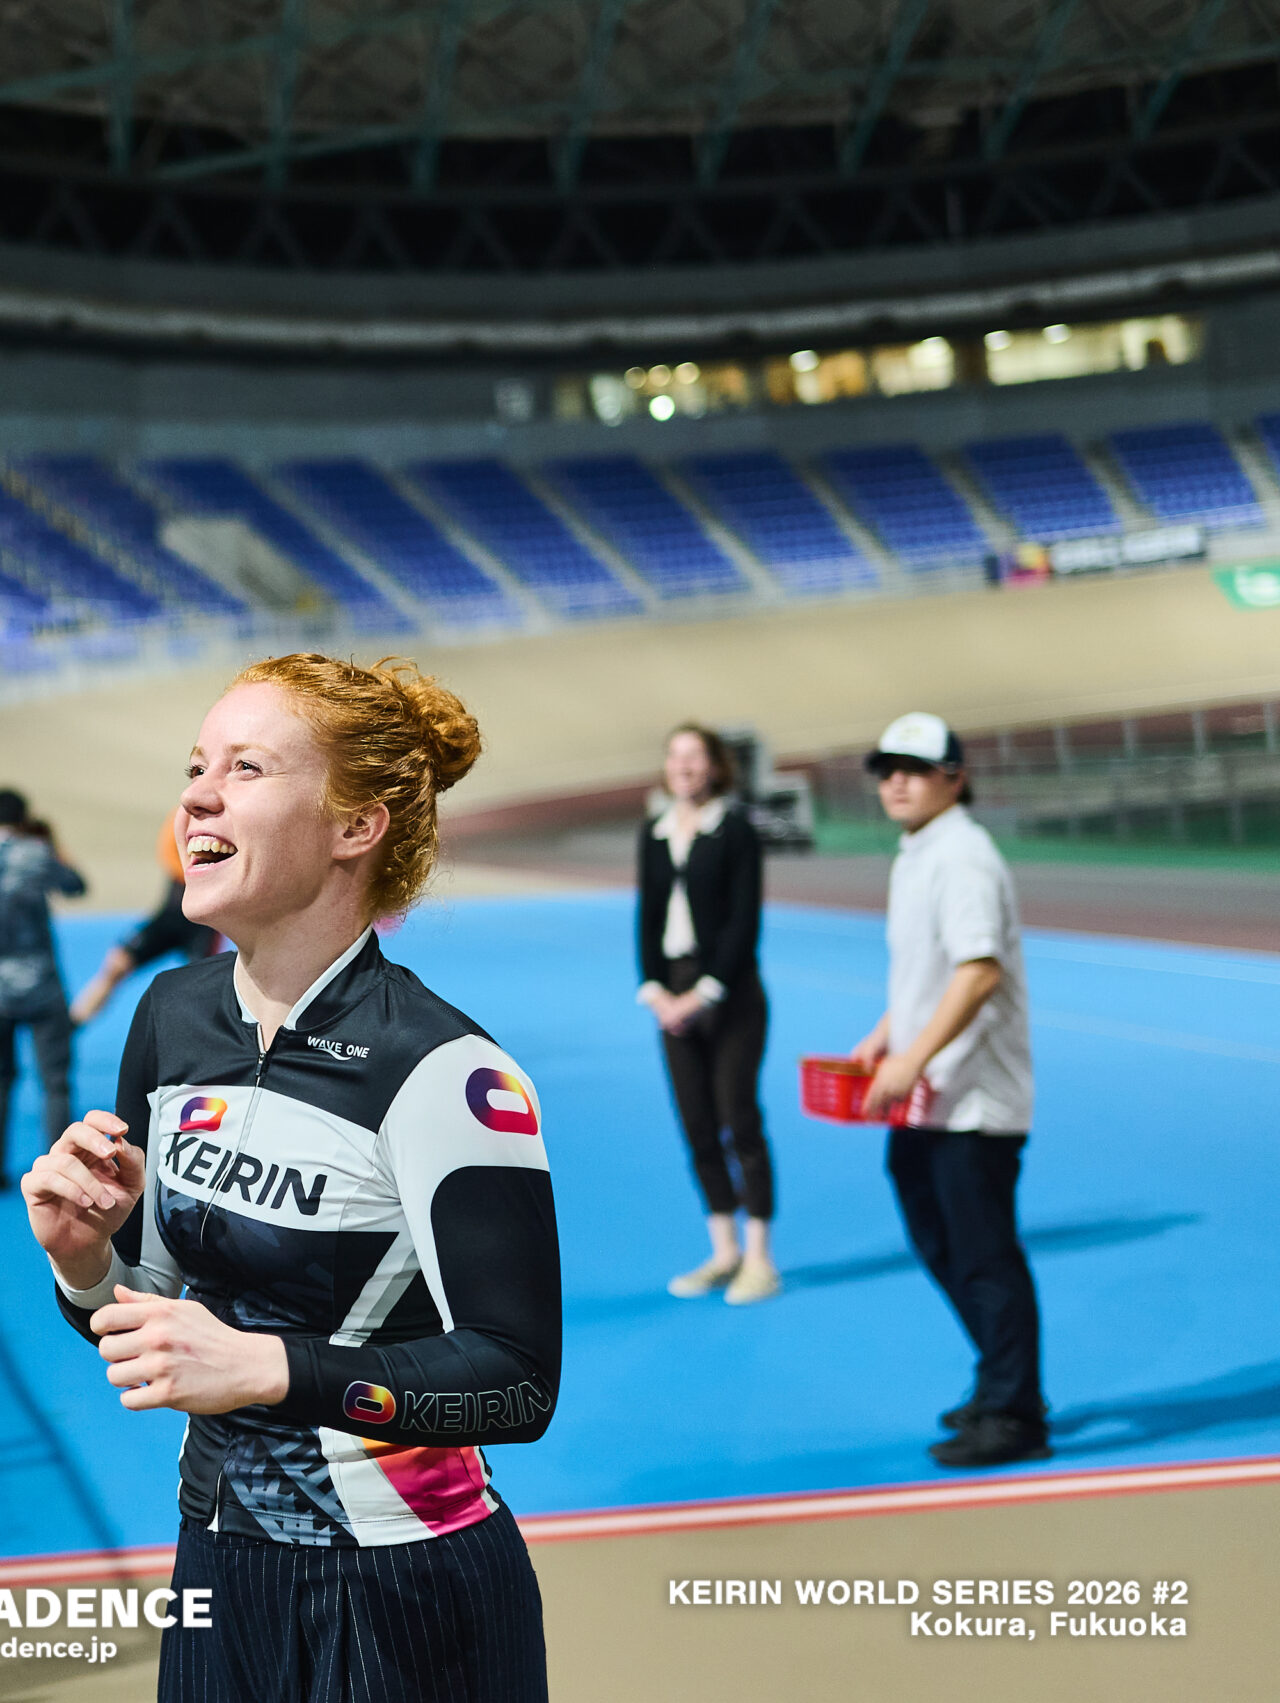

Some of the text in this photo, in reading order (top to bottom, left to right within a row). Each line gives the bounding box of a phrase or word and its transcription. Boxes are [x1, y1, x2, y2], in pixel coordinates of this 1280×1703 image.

[307, 1036, 371, 1059] WAVE ONE
[164, 1132, 328, 1217] KEIRIN
[399, 1380, 551, 1434] KEIRIN
